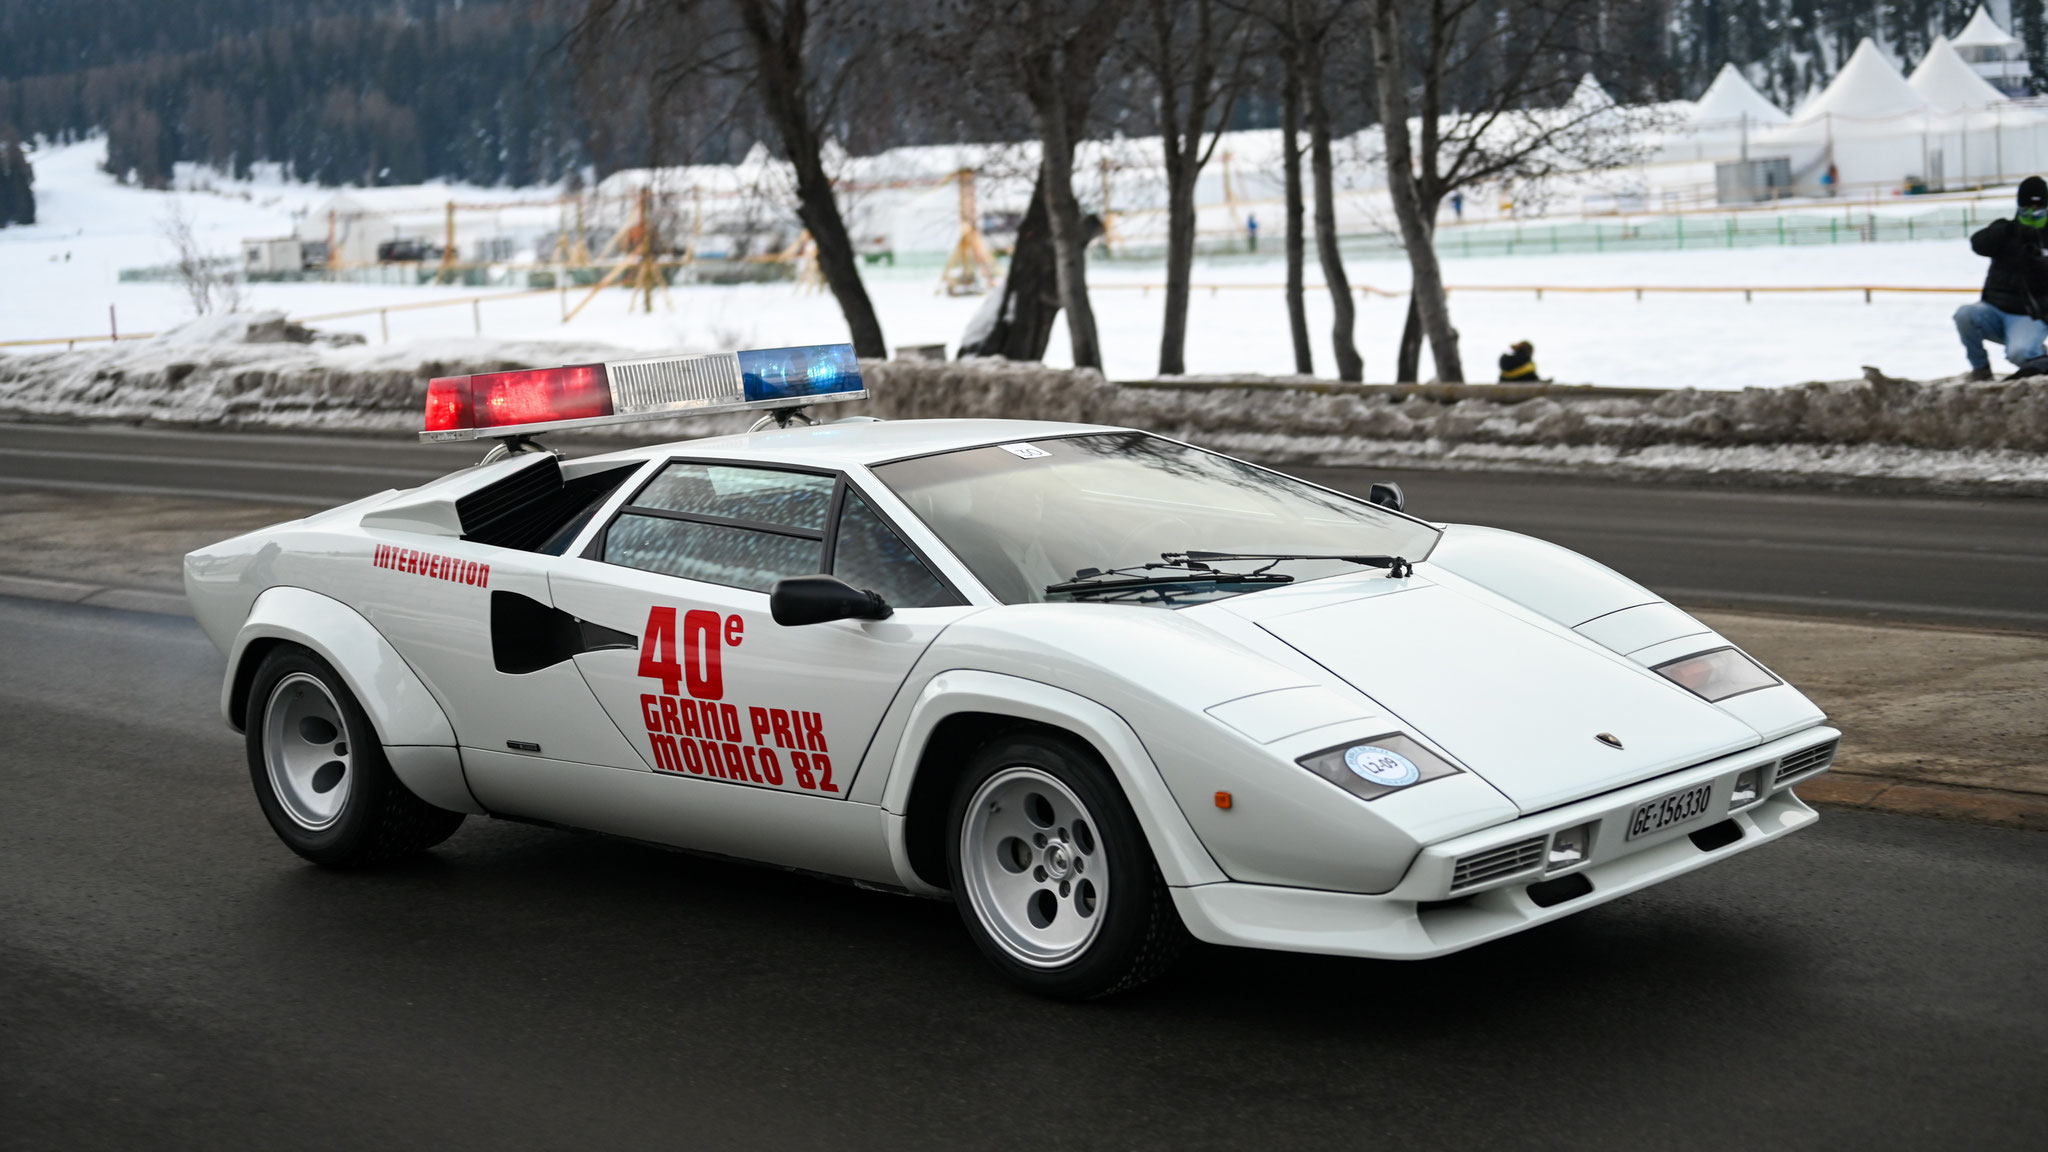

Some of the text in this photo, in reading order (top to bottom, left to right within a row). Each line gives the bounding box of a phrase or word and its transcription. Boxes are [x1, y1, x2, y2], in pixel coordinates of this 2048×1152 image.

[373, 544, 490, 588] INTERVENTION
[638, 606, 744, 701] 40e
[640, 694, 828, 753] GRAND PRIX
[648, 732, 839, 793] MONACO 82
[1361, 757, 1398, 774] L2-09
